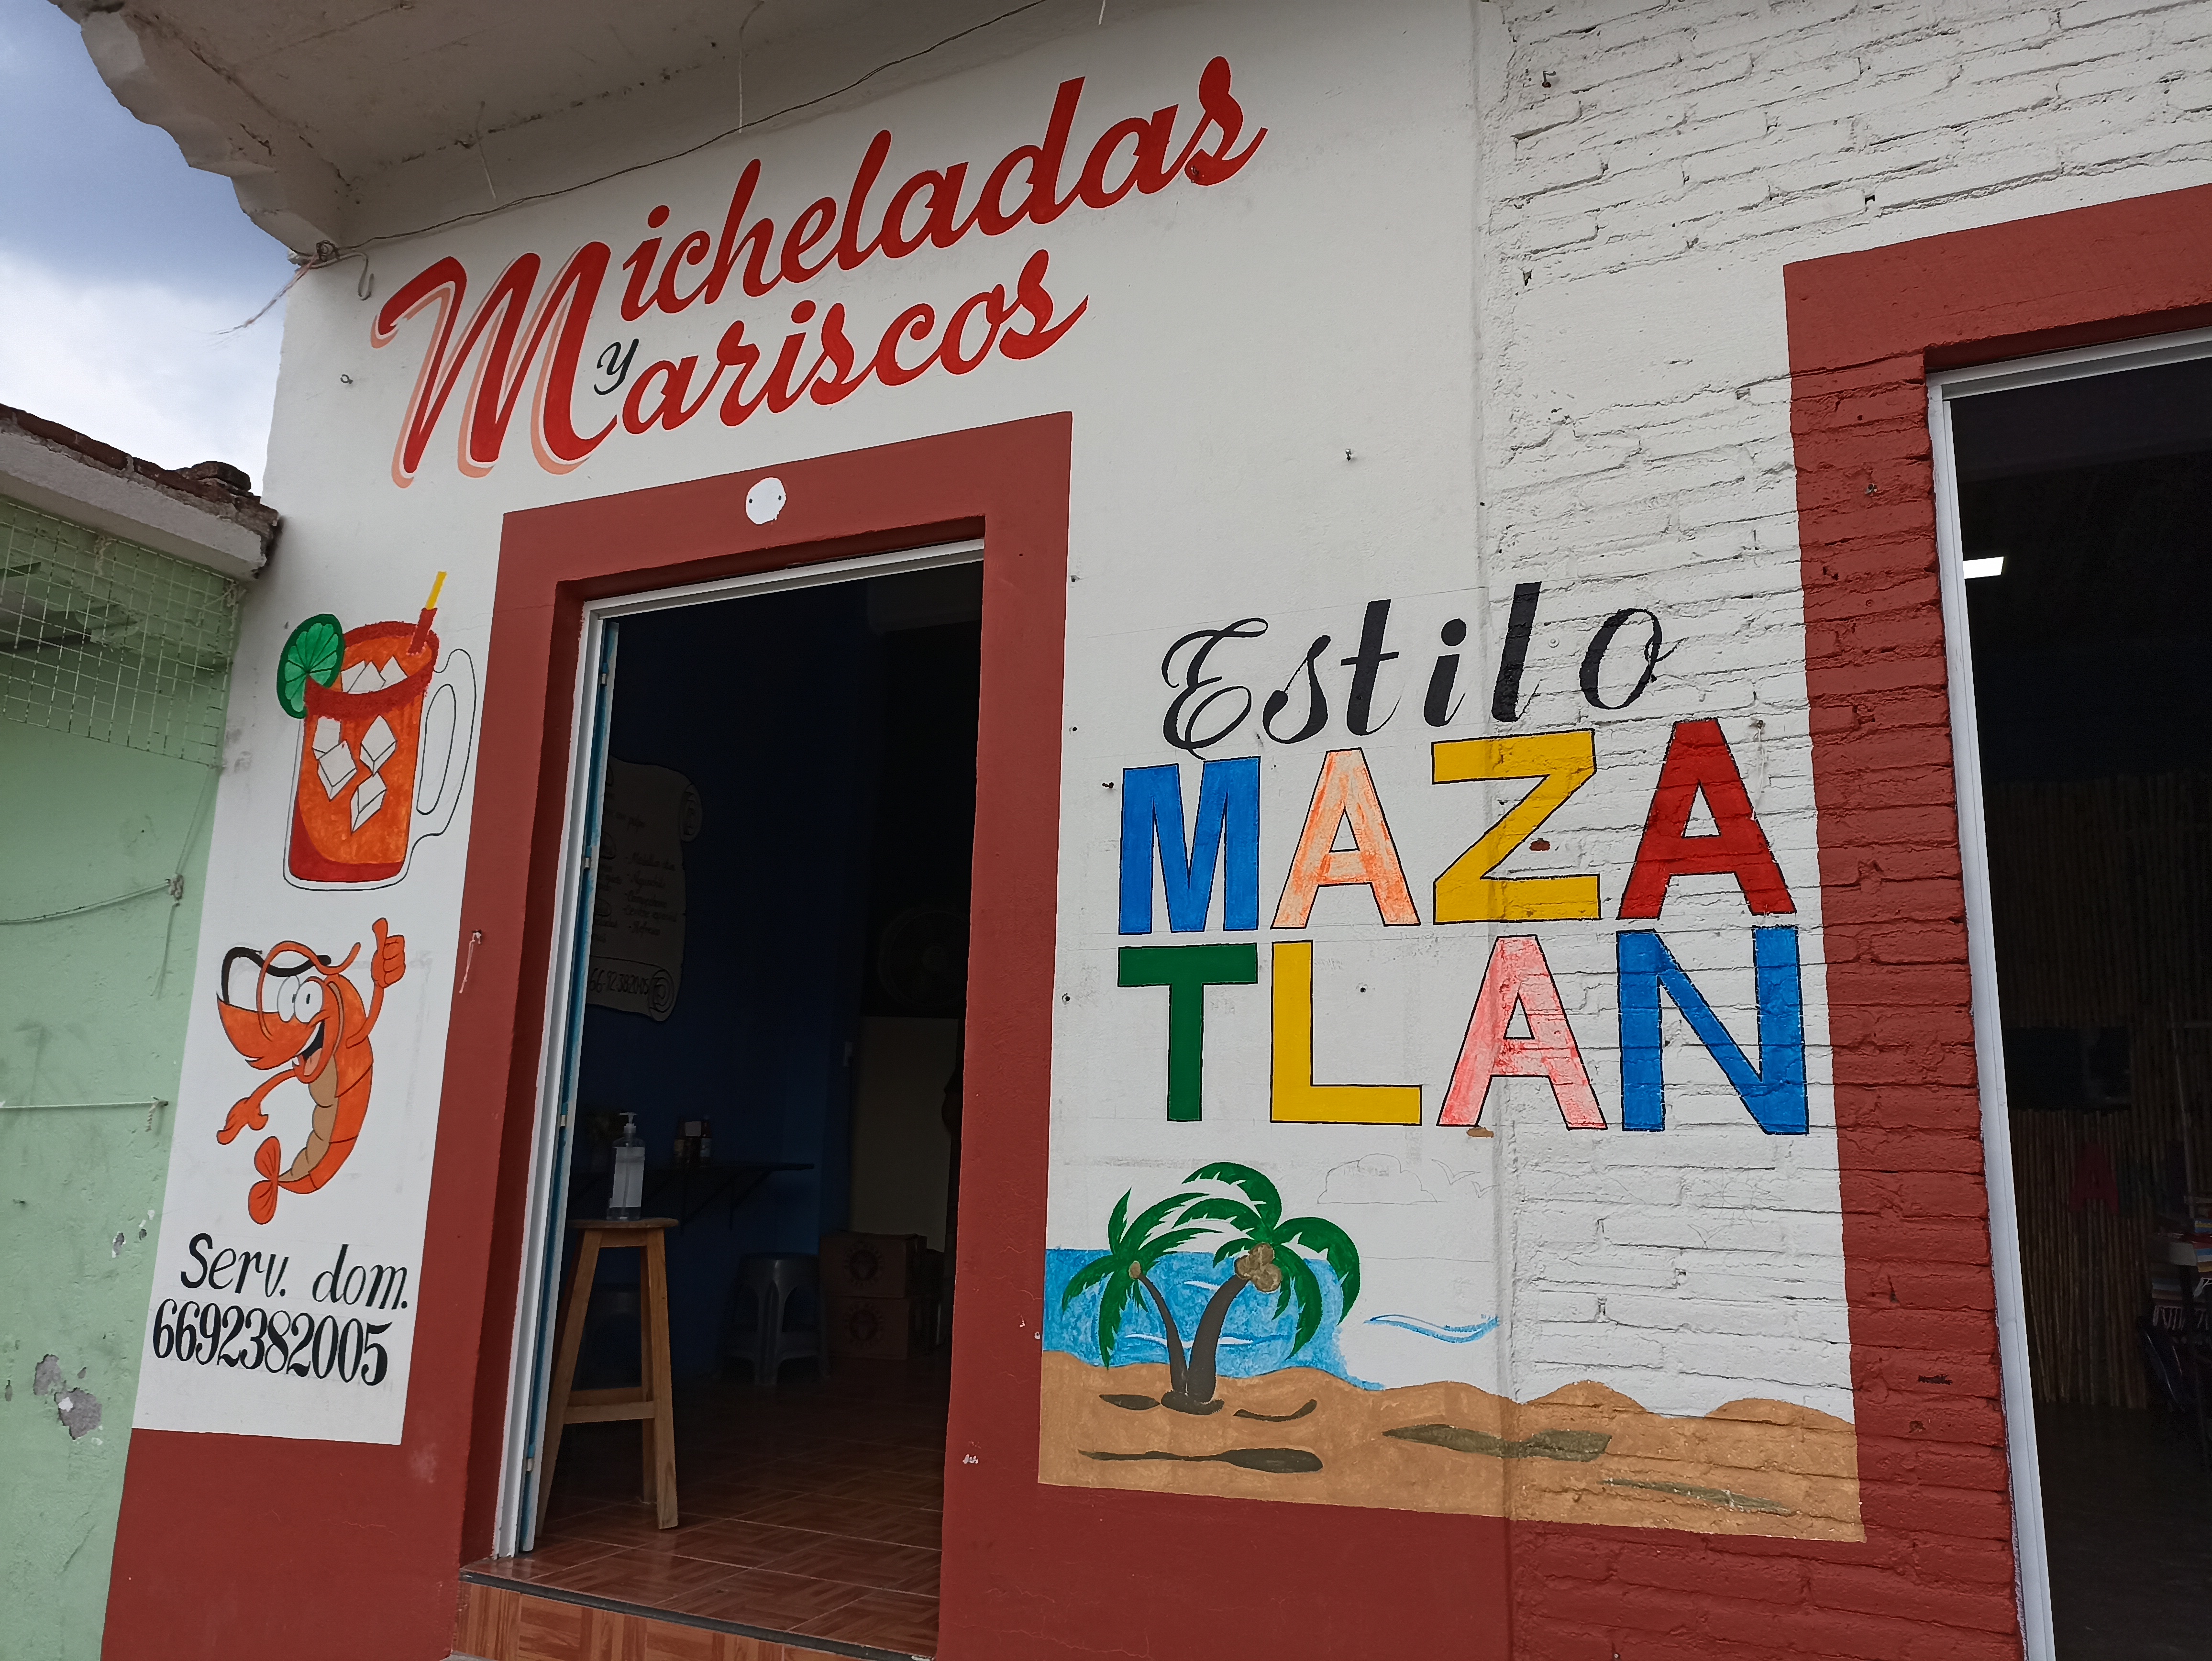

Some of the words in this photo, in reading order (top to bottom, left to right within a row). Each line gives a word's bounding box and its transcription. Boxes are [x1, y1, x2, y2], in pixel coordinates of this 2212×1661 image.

[371, 56, 1268, 488] Micheladas
[1161, 581, 1685, 760] Estilo
[1118, 718, 1797, 935] MAZA
[1117, 925, 1809, 1136] TLAN
[153, 1298, 393, 1386] 6692382005
[180, 1233, 289, 1298] Serv.
[312, 1244, 408, 1309] dom.
